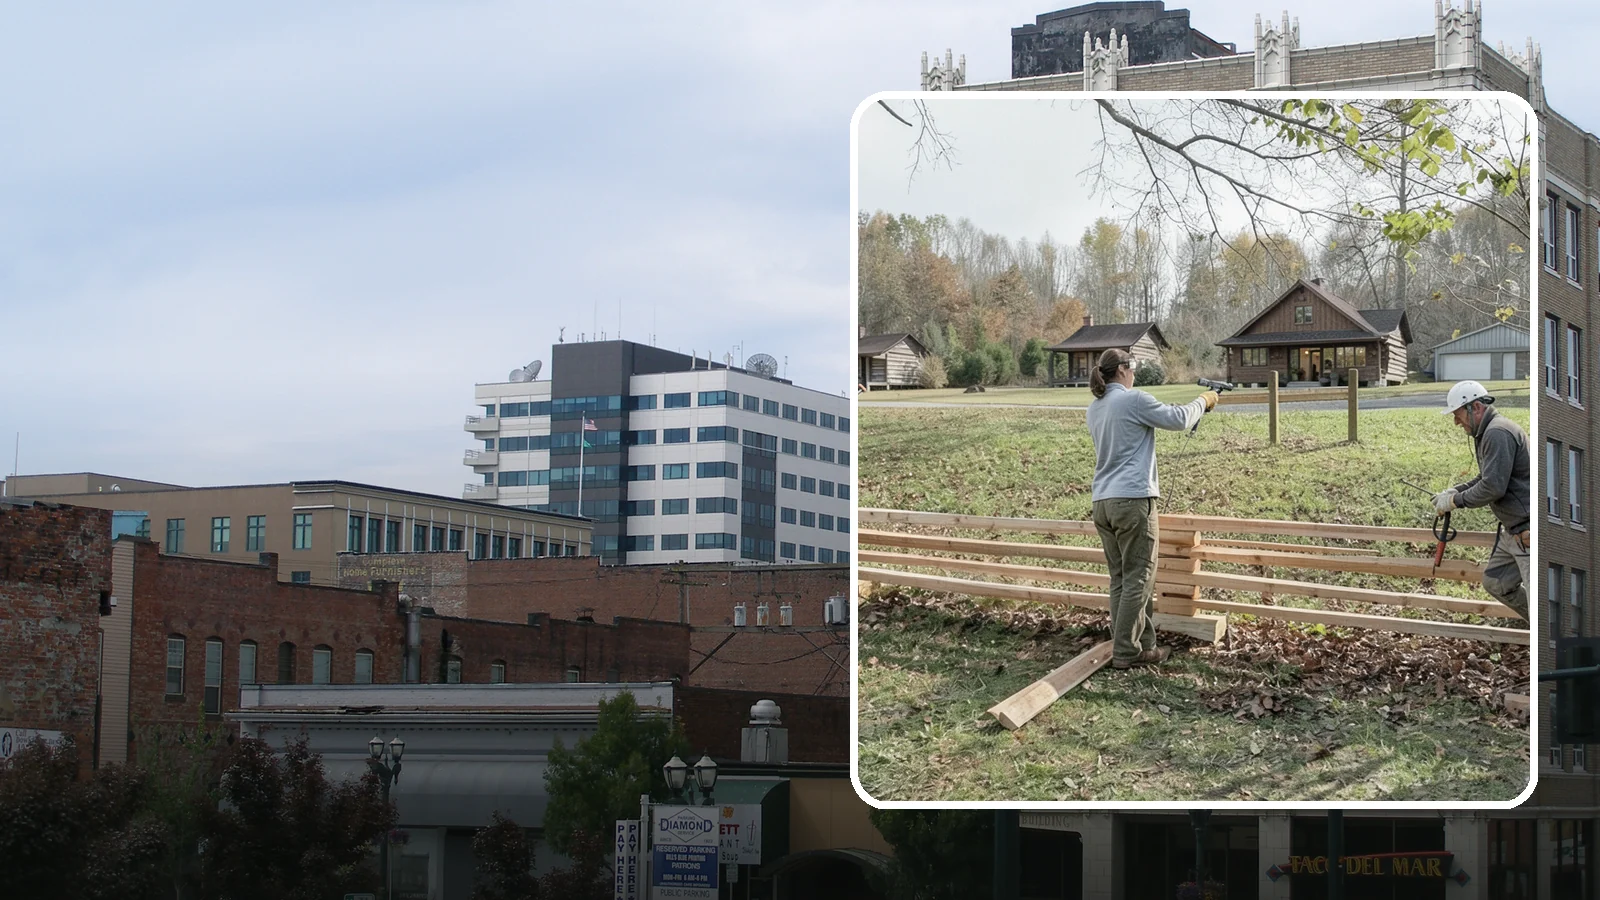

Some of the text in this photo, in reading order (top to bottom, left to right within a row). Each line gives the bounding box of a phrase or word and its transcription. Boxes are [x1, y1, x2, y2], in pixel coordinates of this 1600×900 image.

[343, 567, 427, 577] Home Furnishers
[660, 818, 713, 833] DIAMOND
[1022, 815, 1070, 827] BUILDING
[656, 845, 716, 854] RESERVED PARKING
[616, 824, 625, 893] PAY HERE
[627, 824, 637, 893] PAY HERE
[721, 851, 739, 862] Soup
[1345, 855, 1385, 876] DEL
[1392, 857, 1442, 877] MAR
[660, 888, 710, 899] PUBLIC PARKING
